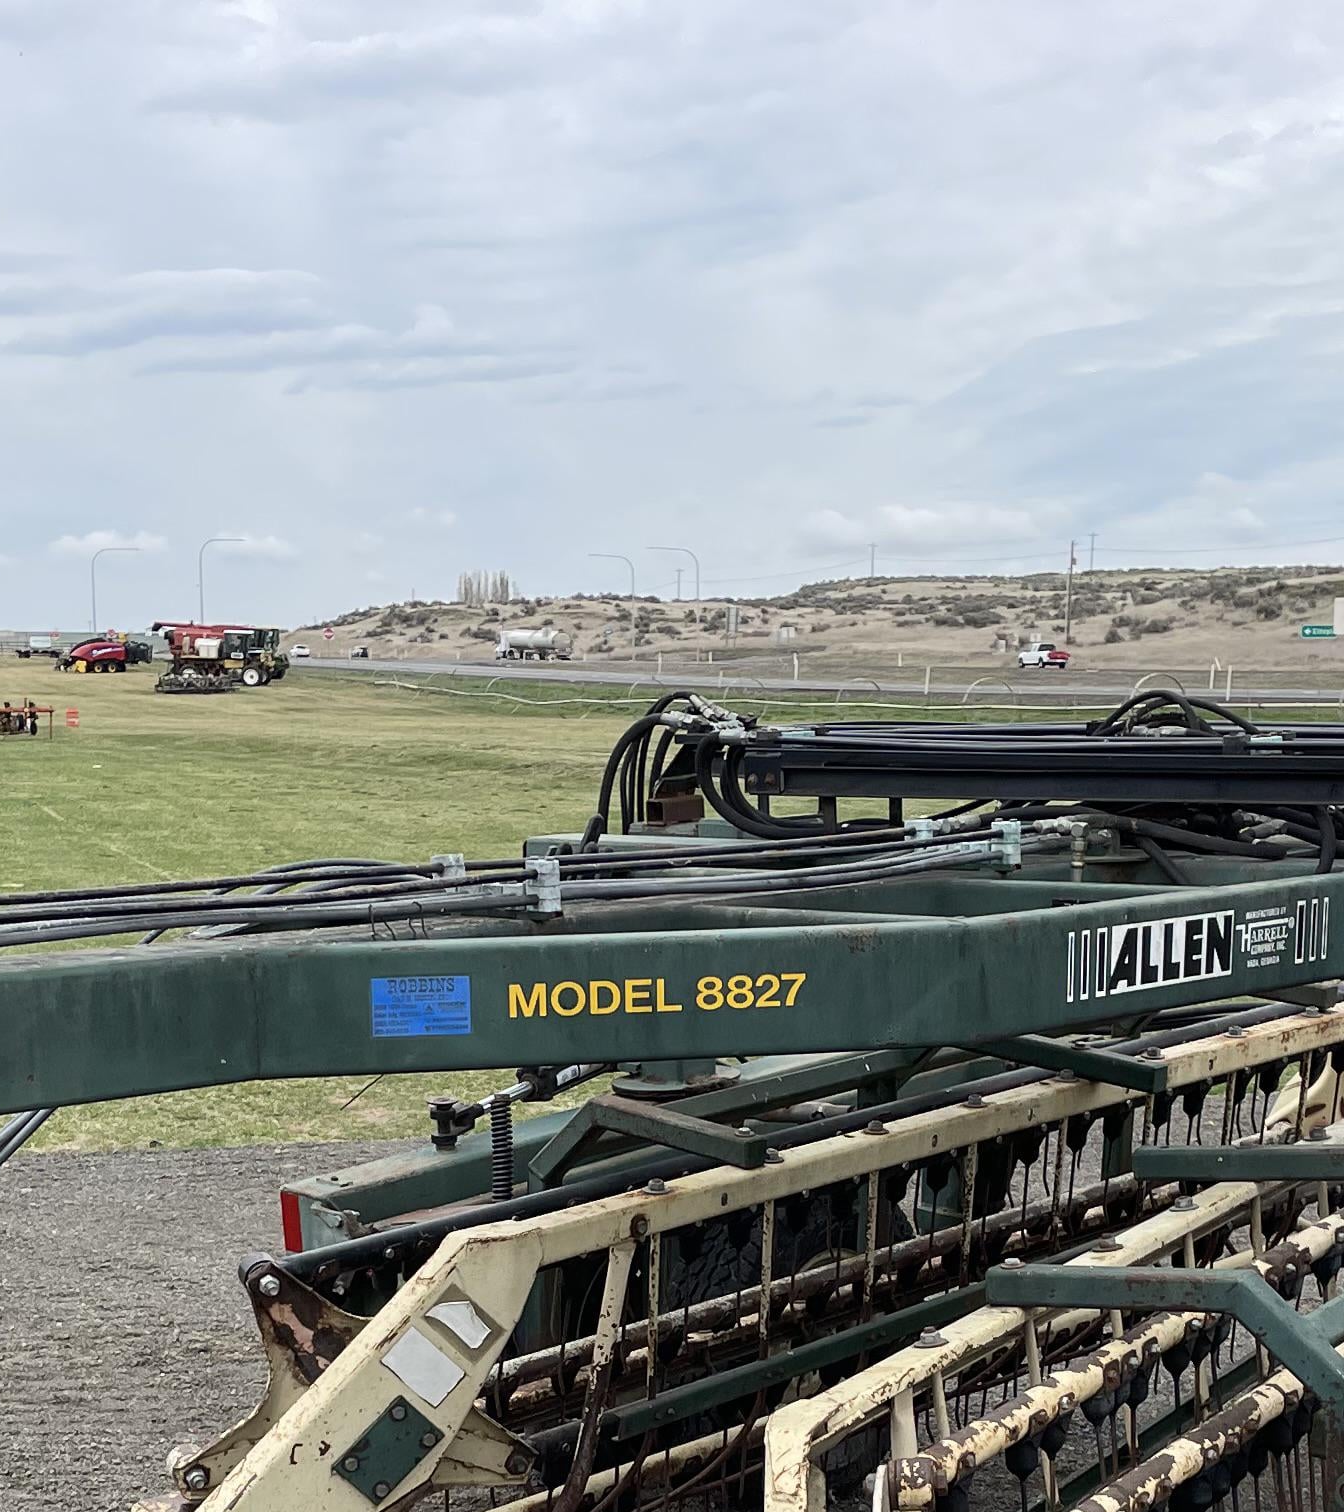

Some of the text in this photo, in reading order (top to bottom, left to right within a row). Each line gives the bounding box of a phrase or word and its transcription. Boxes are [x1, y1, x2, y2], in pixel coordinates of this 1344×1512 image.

[1109, 912, 1234, 992] ALLEN
[387, 977, 455, 993] ROBBINS
[508, 973, 806, 1018] MODEL 8827
